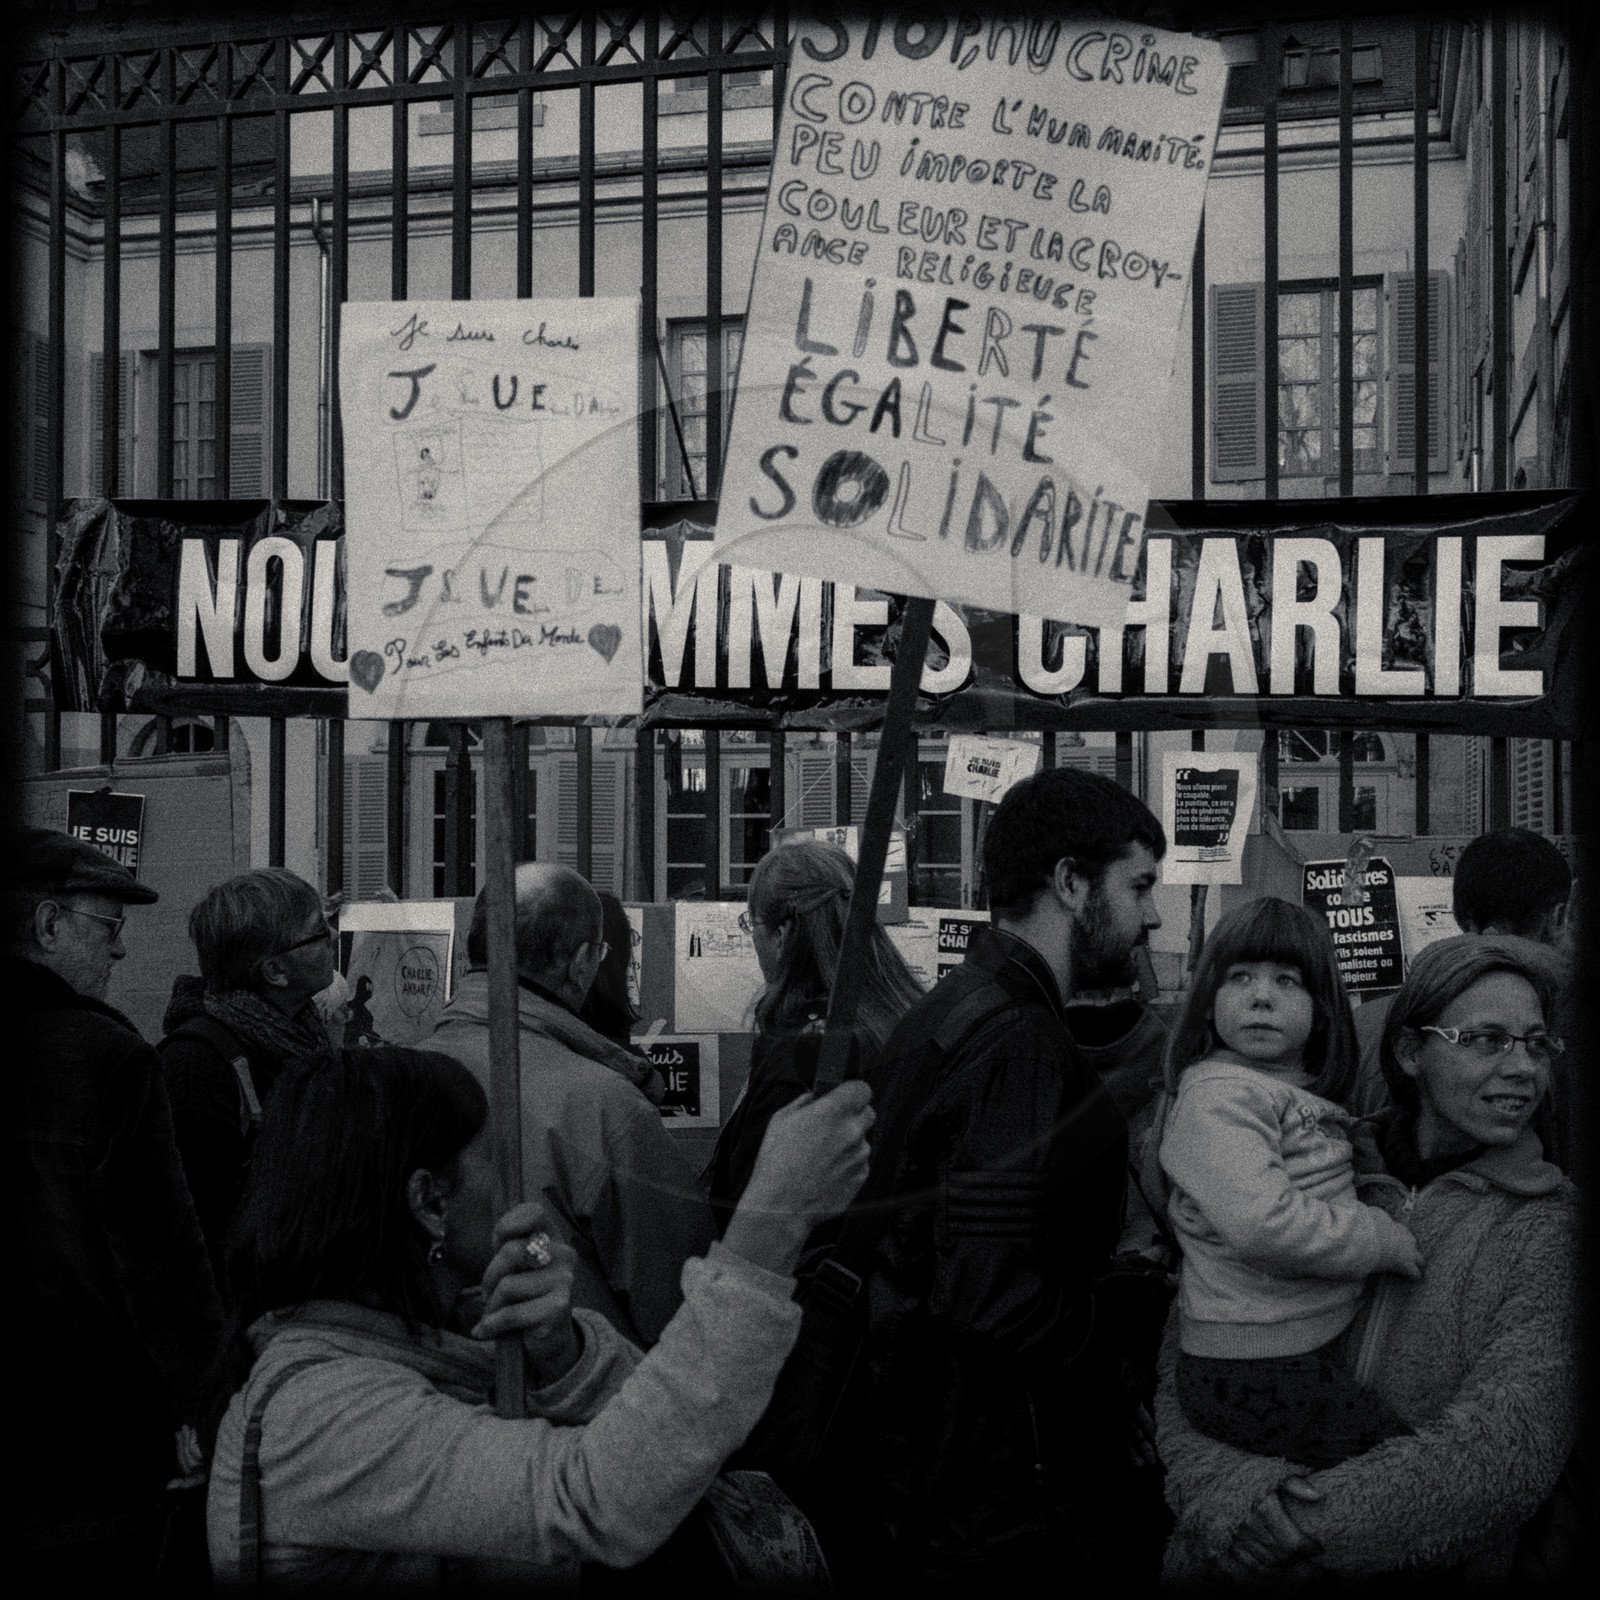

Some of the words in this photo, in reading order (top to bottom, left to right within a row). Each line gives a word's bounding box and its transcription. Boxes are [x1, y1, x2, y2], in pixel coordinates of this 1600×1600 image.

[789, 73, 969, 130] CONTRE
[791, 124, 880, 180] PEU
[1069, 178, 1111, 214] LA
[778, 180, 968, 245] COULEUR
[977, 215, 1029, 251] ET
[1031, 228, 1064, 264] LA
[772, 222, 869, 265] ANCE
[177, 538, 348, 682] NOU
[643, 540, 971, 696] MMES
[967, 763, 1000, 778] CHARLIE
[73, 825, 92, 841] JE
[95, 827, 138, 845] SUIS
[1307, 868, 1388, 890] Solidres
[1326, 891, 1371, 906] coe
[1325, 906, 1375, 928] TOUS
[940, 924, 957, 934] JE
[1333, 929, 1394, 944] fascismes
[1353, 946, 1383, 957] soient
[1380, 958, 1393, 968] ou
